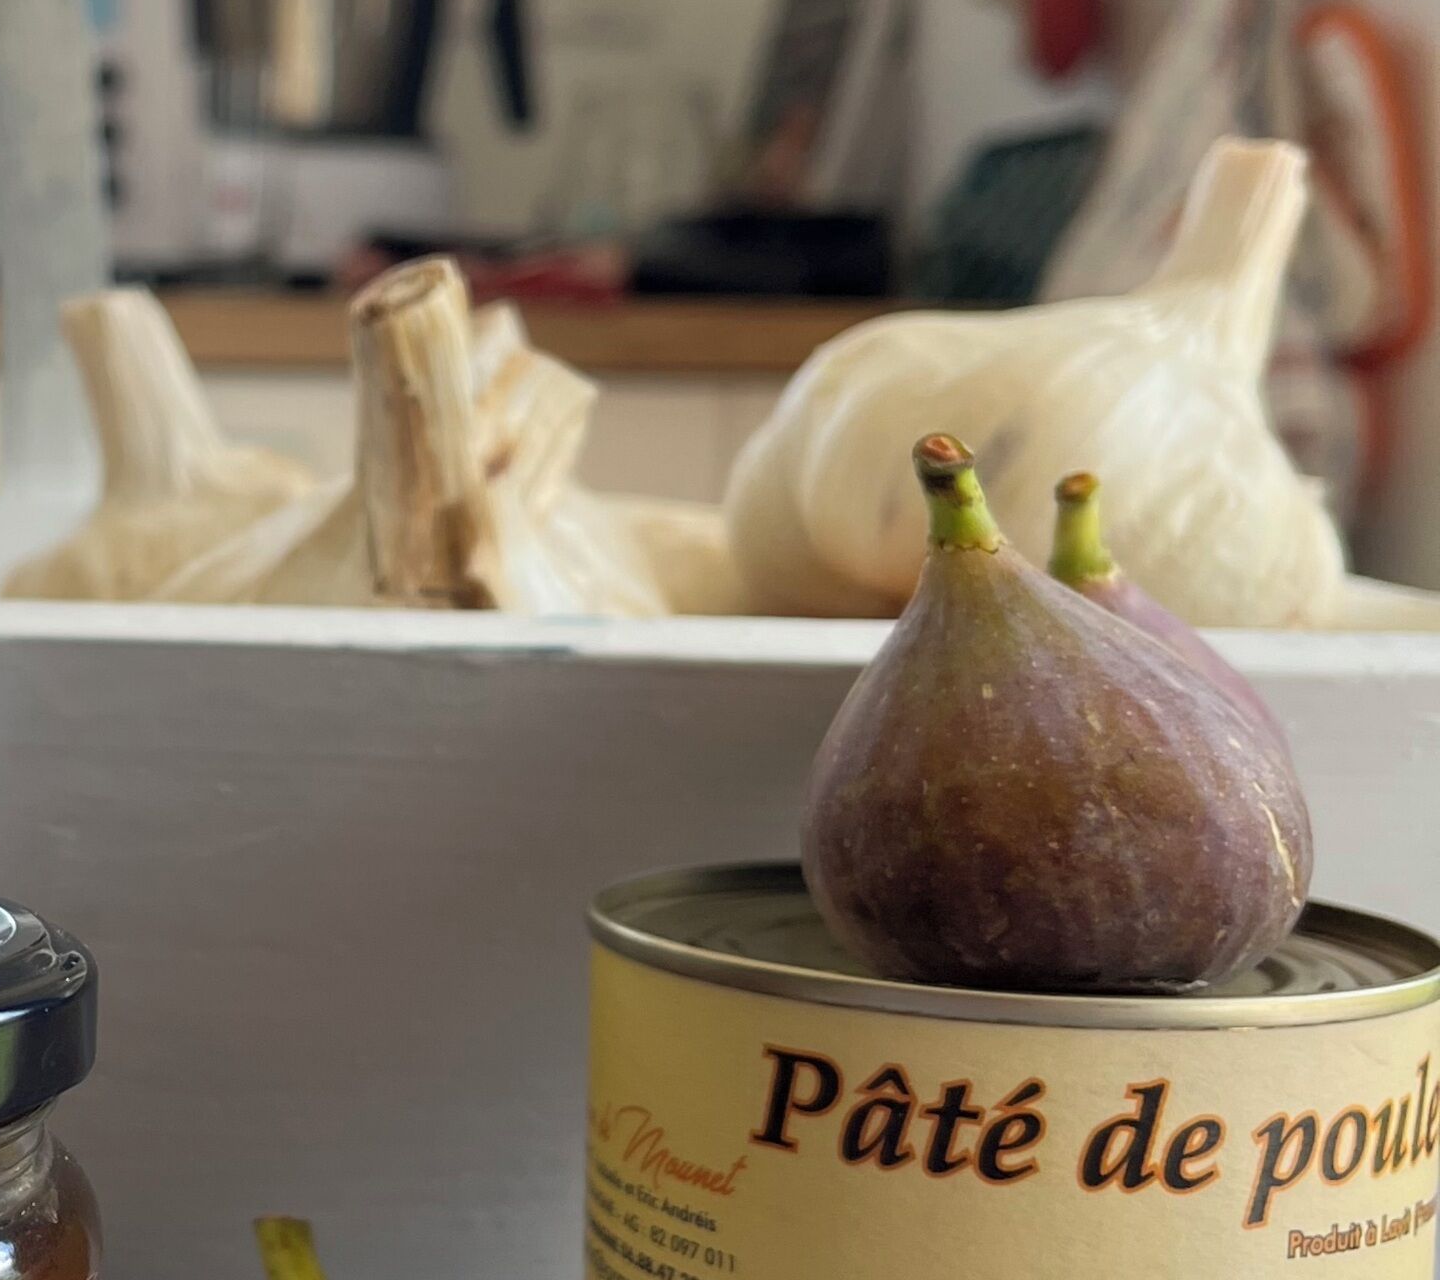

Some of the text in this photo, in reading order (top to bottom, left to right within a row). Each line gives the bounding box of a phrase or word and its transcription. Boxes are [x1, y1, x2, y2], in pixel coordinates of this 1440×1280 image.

[748, 1042, 1047, 1186] Pâté
[1077, 1077, 1227, 1195] de
[1287, 1223, 1362, 1259] Produit
[1364, 1220, 1377, 1247] à
